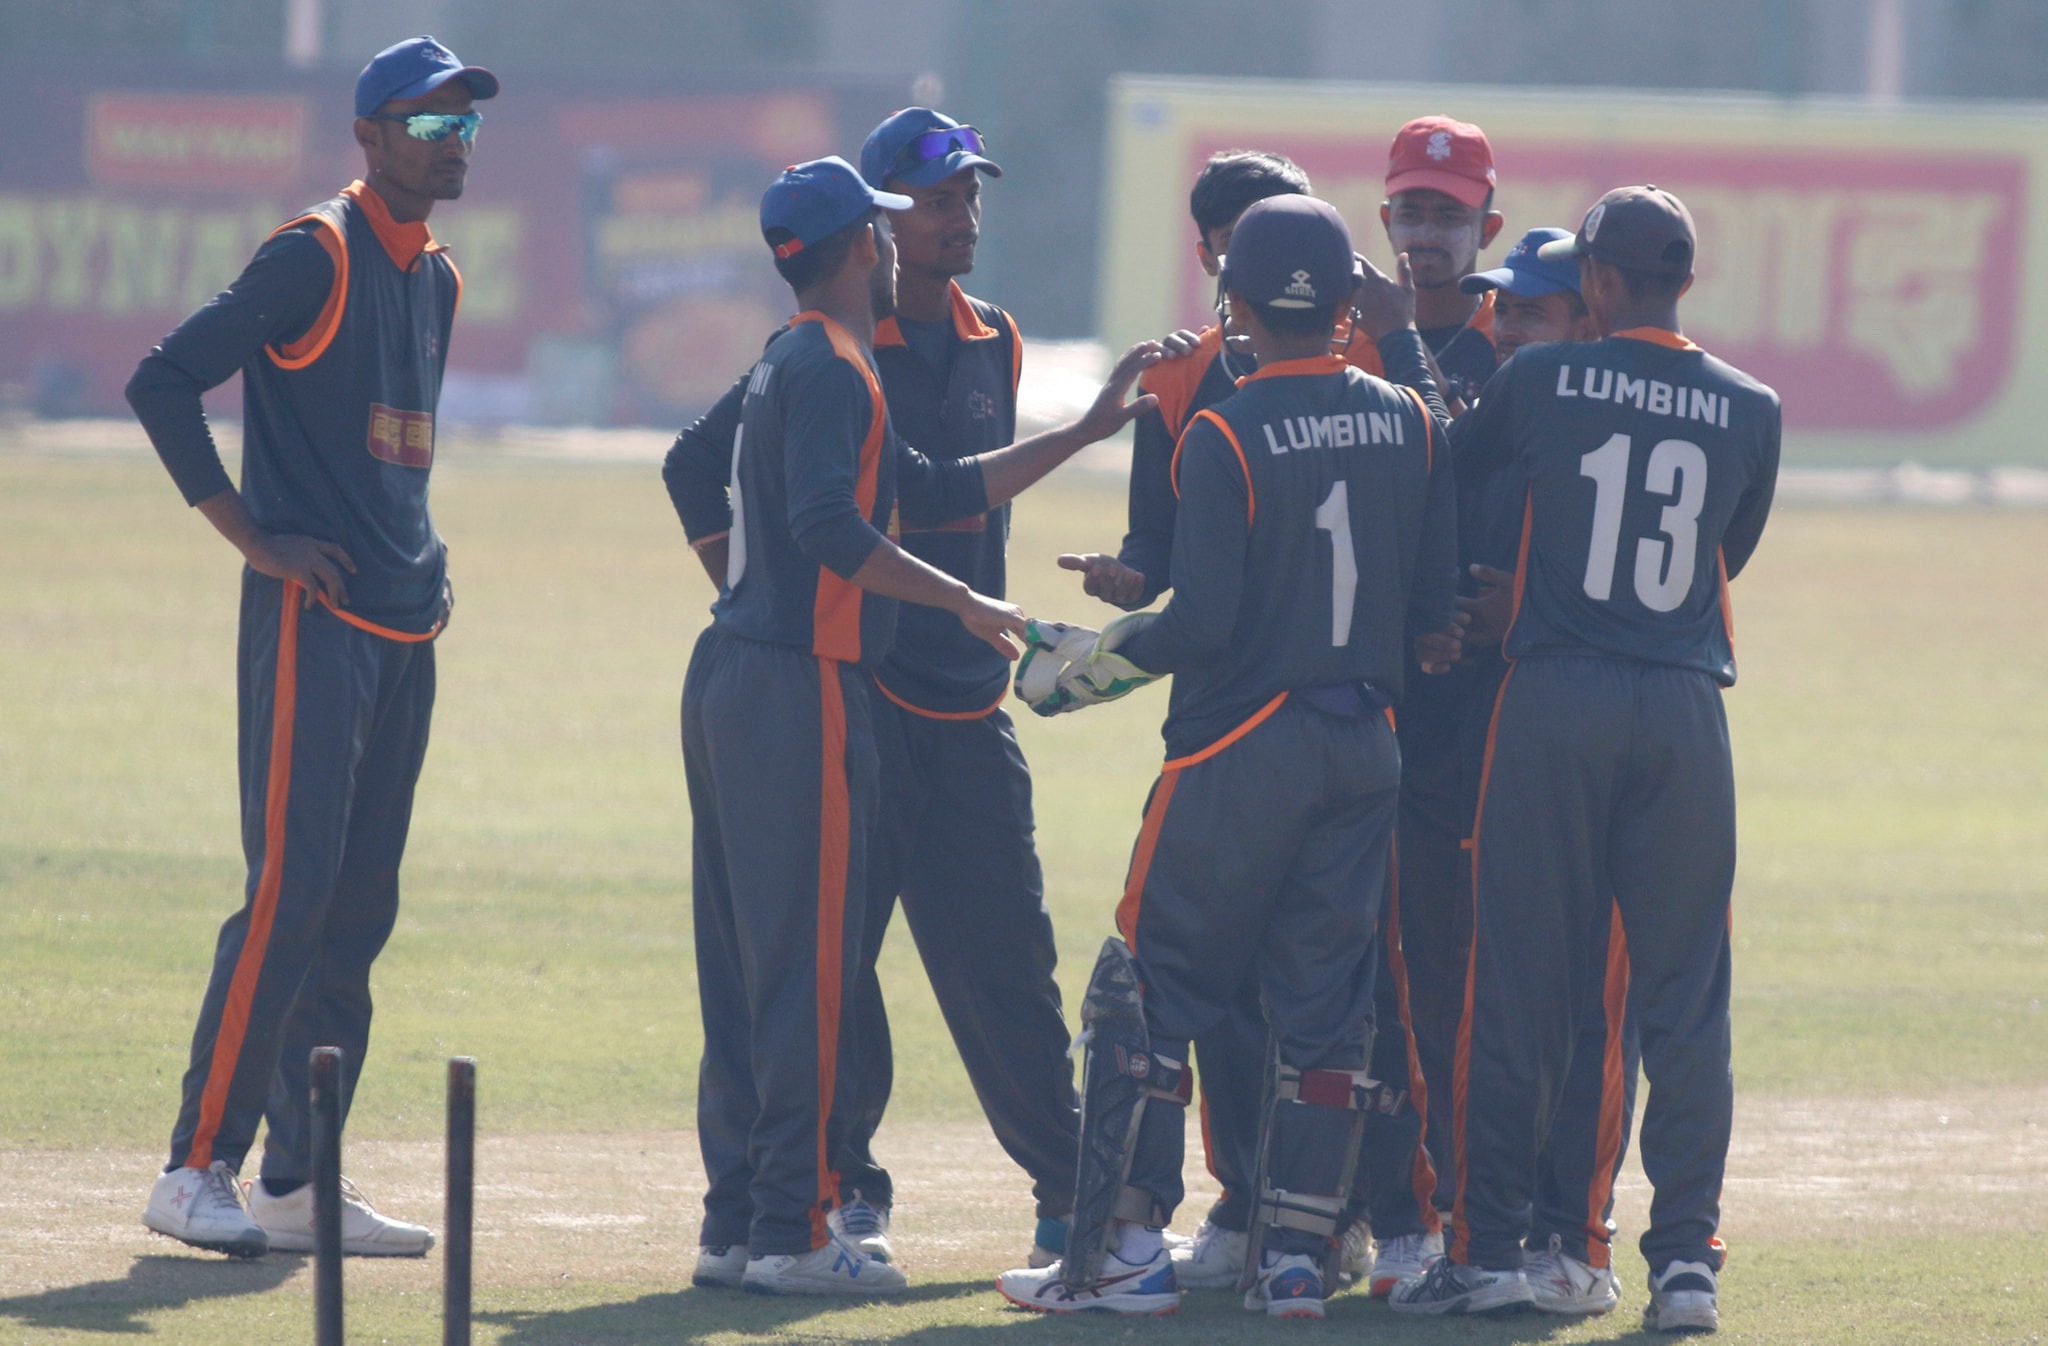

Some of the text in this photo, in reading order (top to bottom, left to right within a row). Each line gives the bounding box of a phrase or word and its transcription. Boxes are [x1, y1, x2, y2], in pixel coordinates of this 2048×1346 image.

[1262, 412, 1404, 455] LUMBINI
[1556, 364, 1730, 429] LUMBINI
[1315, 480, 1358, 647] 1
[1579, 433, 1708, 612] 13
